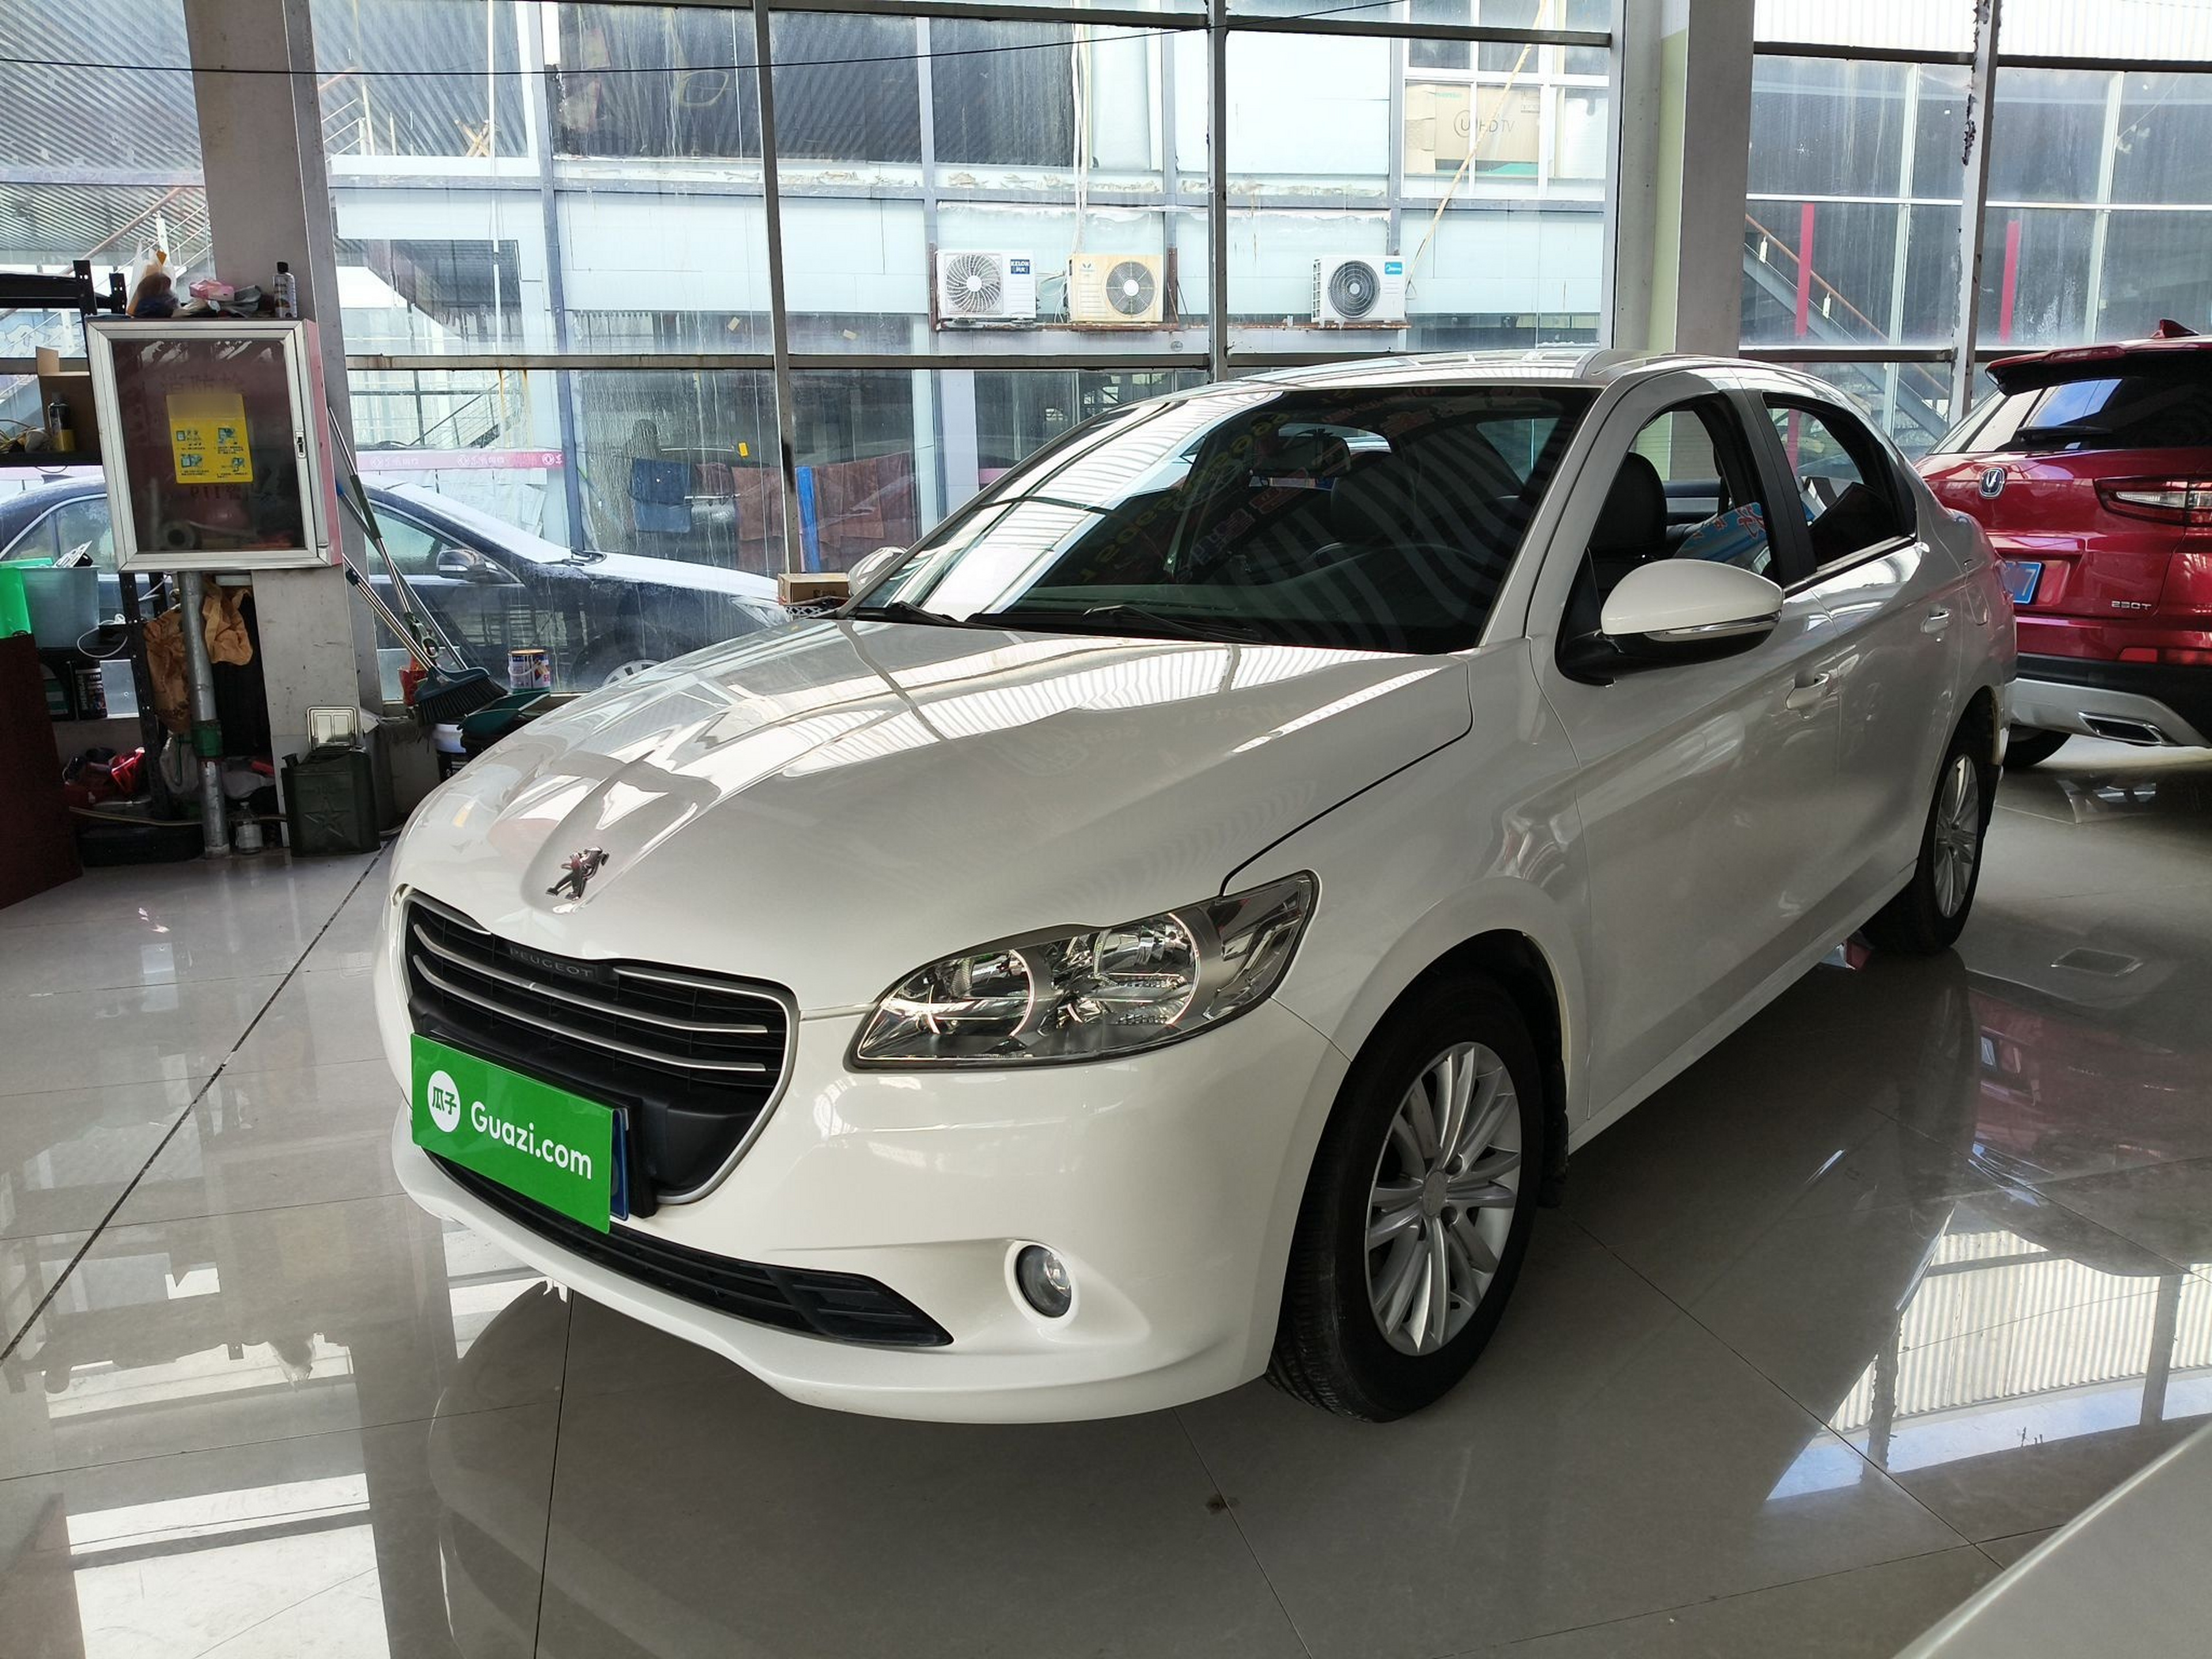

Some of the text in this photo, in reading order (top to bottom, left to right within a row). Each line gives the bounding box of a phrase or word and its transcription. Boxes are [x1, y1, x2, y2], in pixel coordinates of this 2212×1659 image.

[510, 948, 593, 977] PEUGEOT
[432, 1086, 457, 1115] 瓜子
[471, 1101, 592, 1180] Guazi.com
